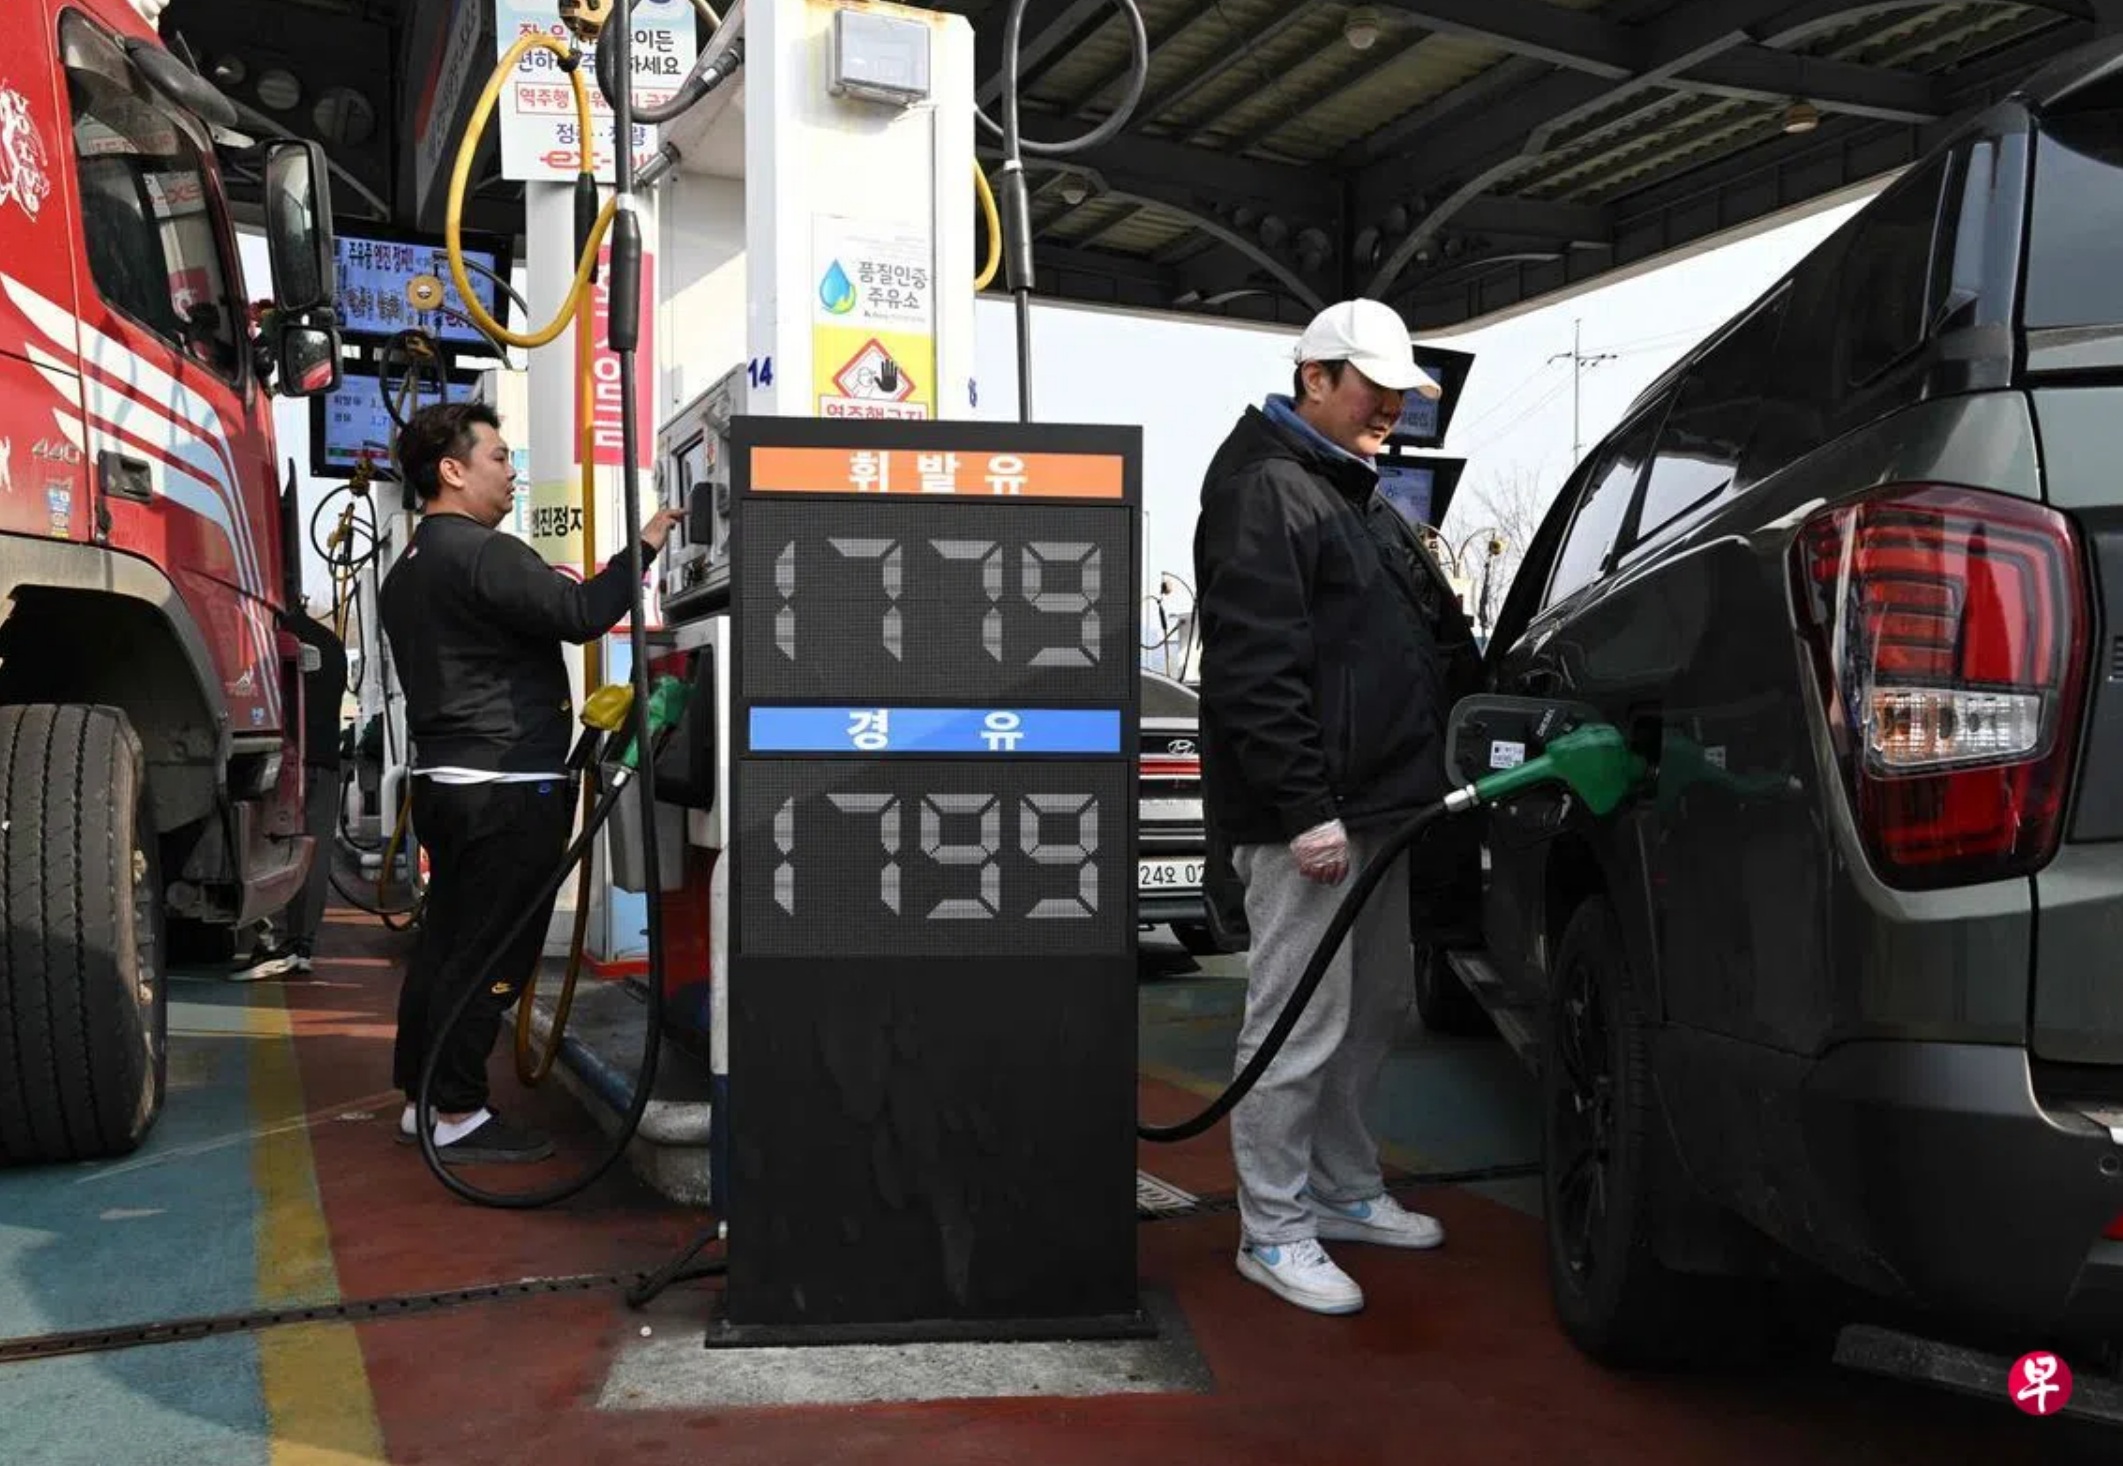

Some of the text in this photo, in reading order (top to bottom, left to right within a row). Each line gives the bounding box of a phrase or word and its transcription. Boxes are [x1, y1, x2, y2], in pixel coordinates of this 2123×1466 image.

[630, 28, 675, 53] 이든
[518, 49, 683, 76] 편하 주세요
[519, 87, 570, 108] 역주행
[857, 261, 928, 290] 품질인증
[867, 286, 921, 309] 주유소
[748, 356, 773, 388] 14
[32, 437, 80, 465] 440
[848, 450, 1029, 495] 휘발유
[774, 537, 1101, 667] 1779
[773, 793, 1099, 919] 1799
[1139, 864, 1177, 886] 24오
